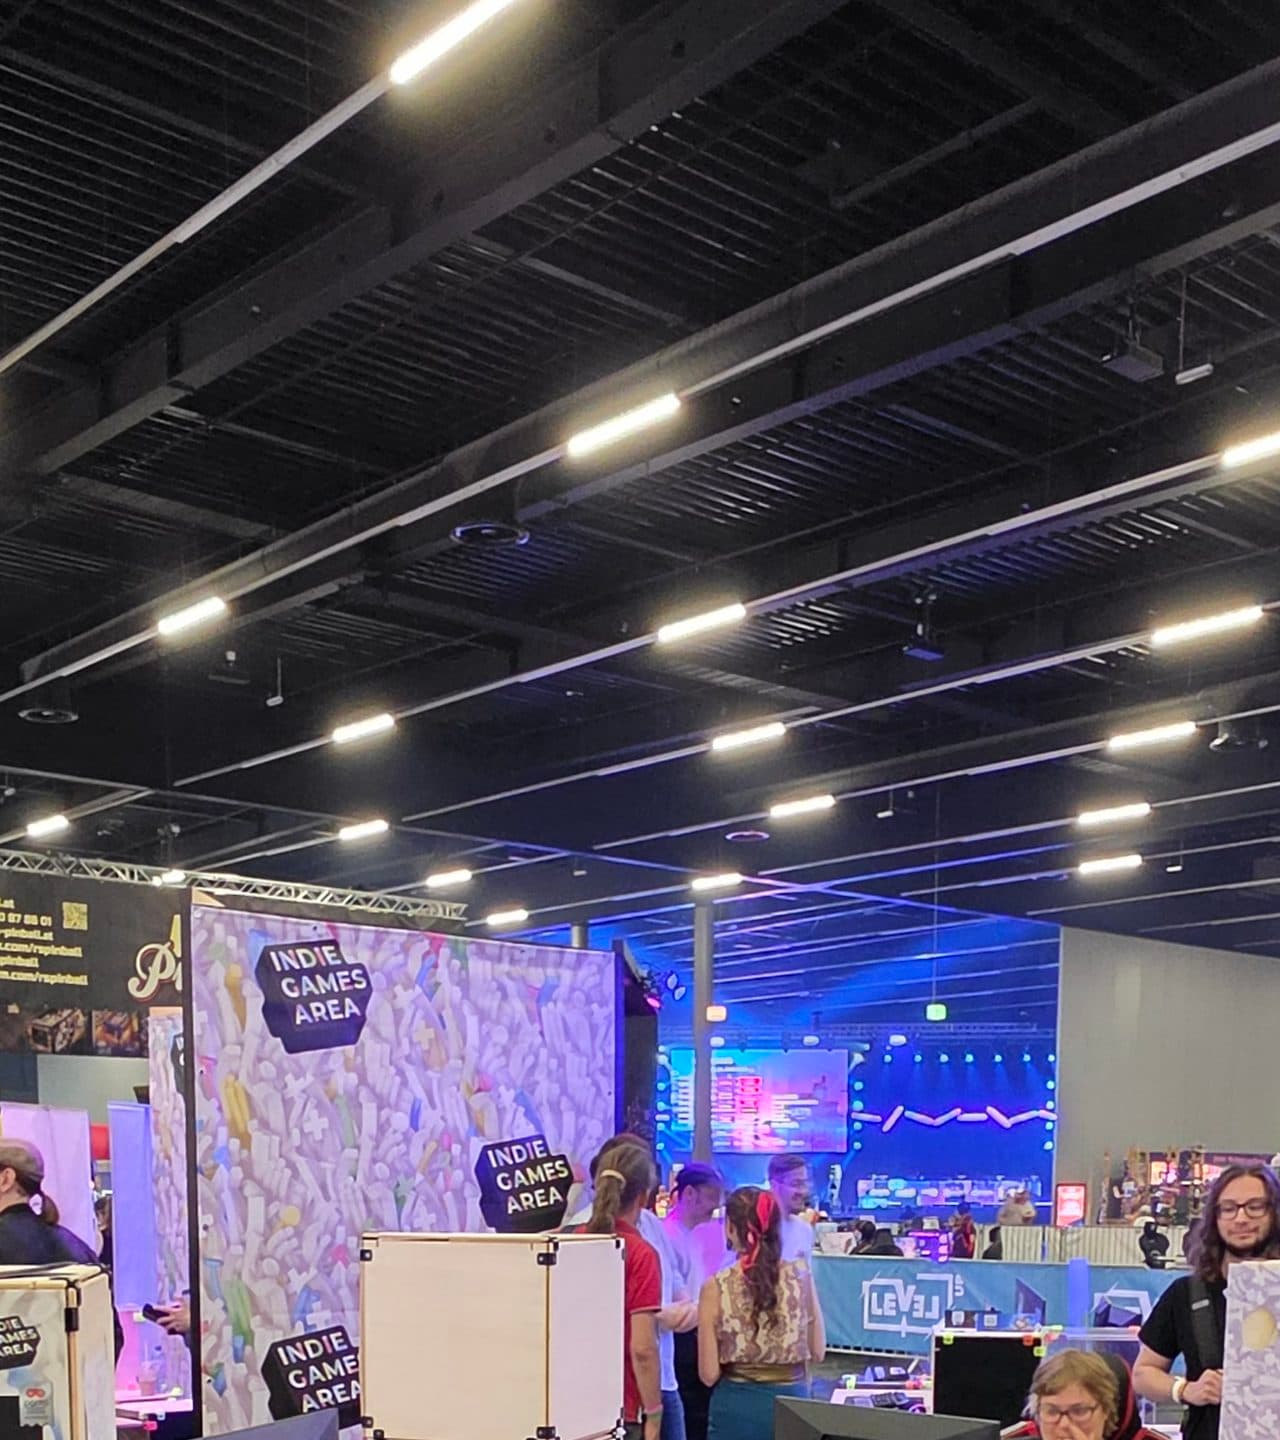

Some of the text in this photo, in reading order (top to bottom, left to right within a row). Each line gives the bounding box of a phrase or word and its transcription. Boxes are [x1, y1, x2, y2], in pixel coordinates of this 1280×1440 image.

[270, 946, 342, 972] INDIE
[280, 969, 368, 998] GAMES
[294, 1000, 361, 1025] AREA
[487, 1139, 547, 1168] INDIE
[496, 1160, 569, 1191] GAMES
[507, 1186, 563, 1215] AREA
[277, 1332, 348, 1366] INDIE
[288, 1354, 359, 1389] GAME
[302, 1380, 361, 1413] AREA
